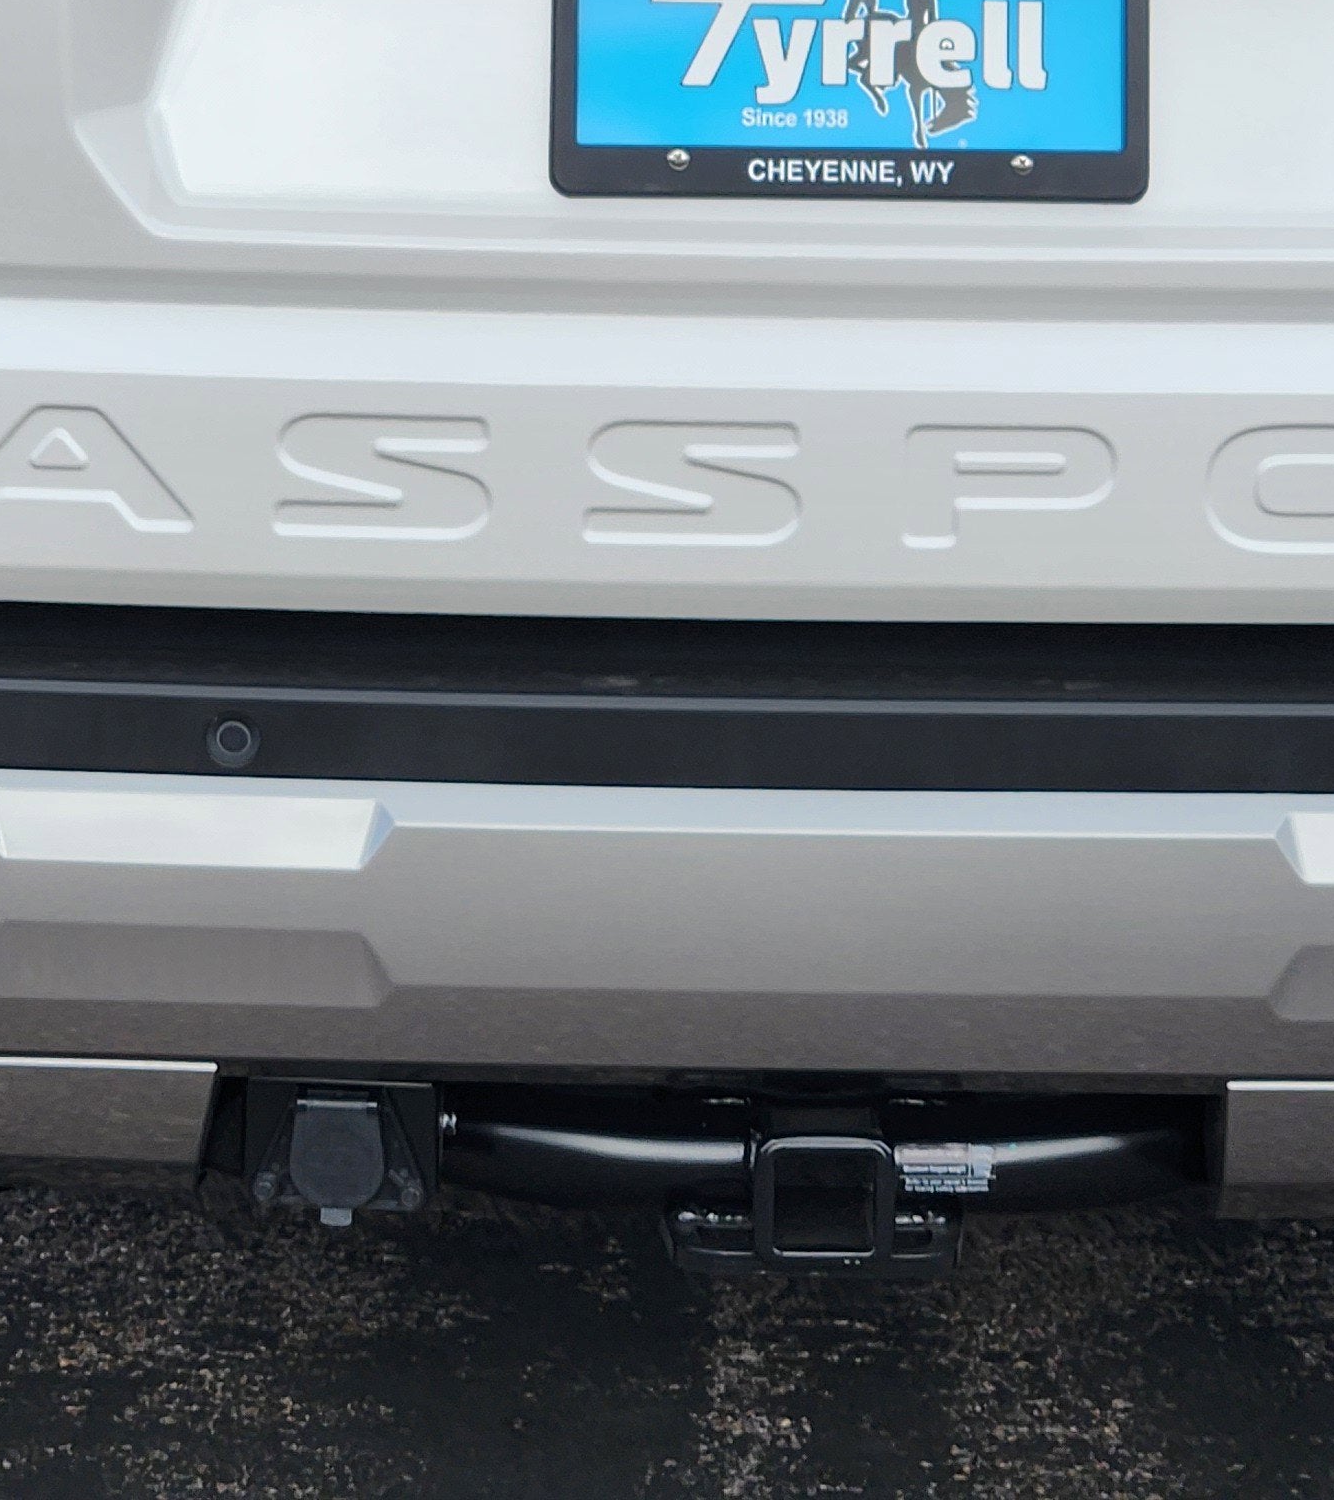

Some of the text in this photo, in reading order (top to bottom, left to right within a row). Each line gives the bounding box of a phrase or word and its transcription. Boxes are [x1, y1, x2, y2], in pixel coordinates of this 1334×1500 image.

[740, 106, 849, 130] Since 1938
[747, 159, 955, 188] CHEYENNE, WY
